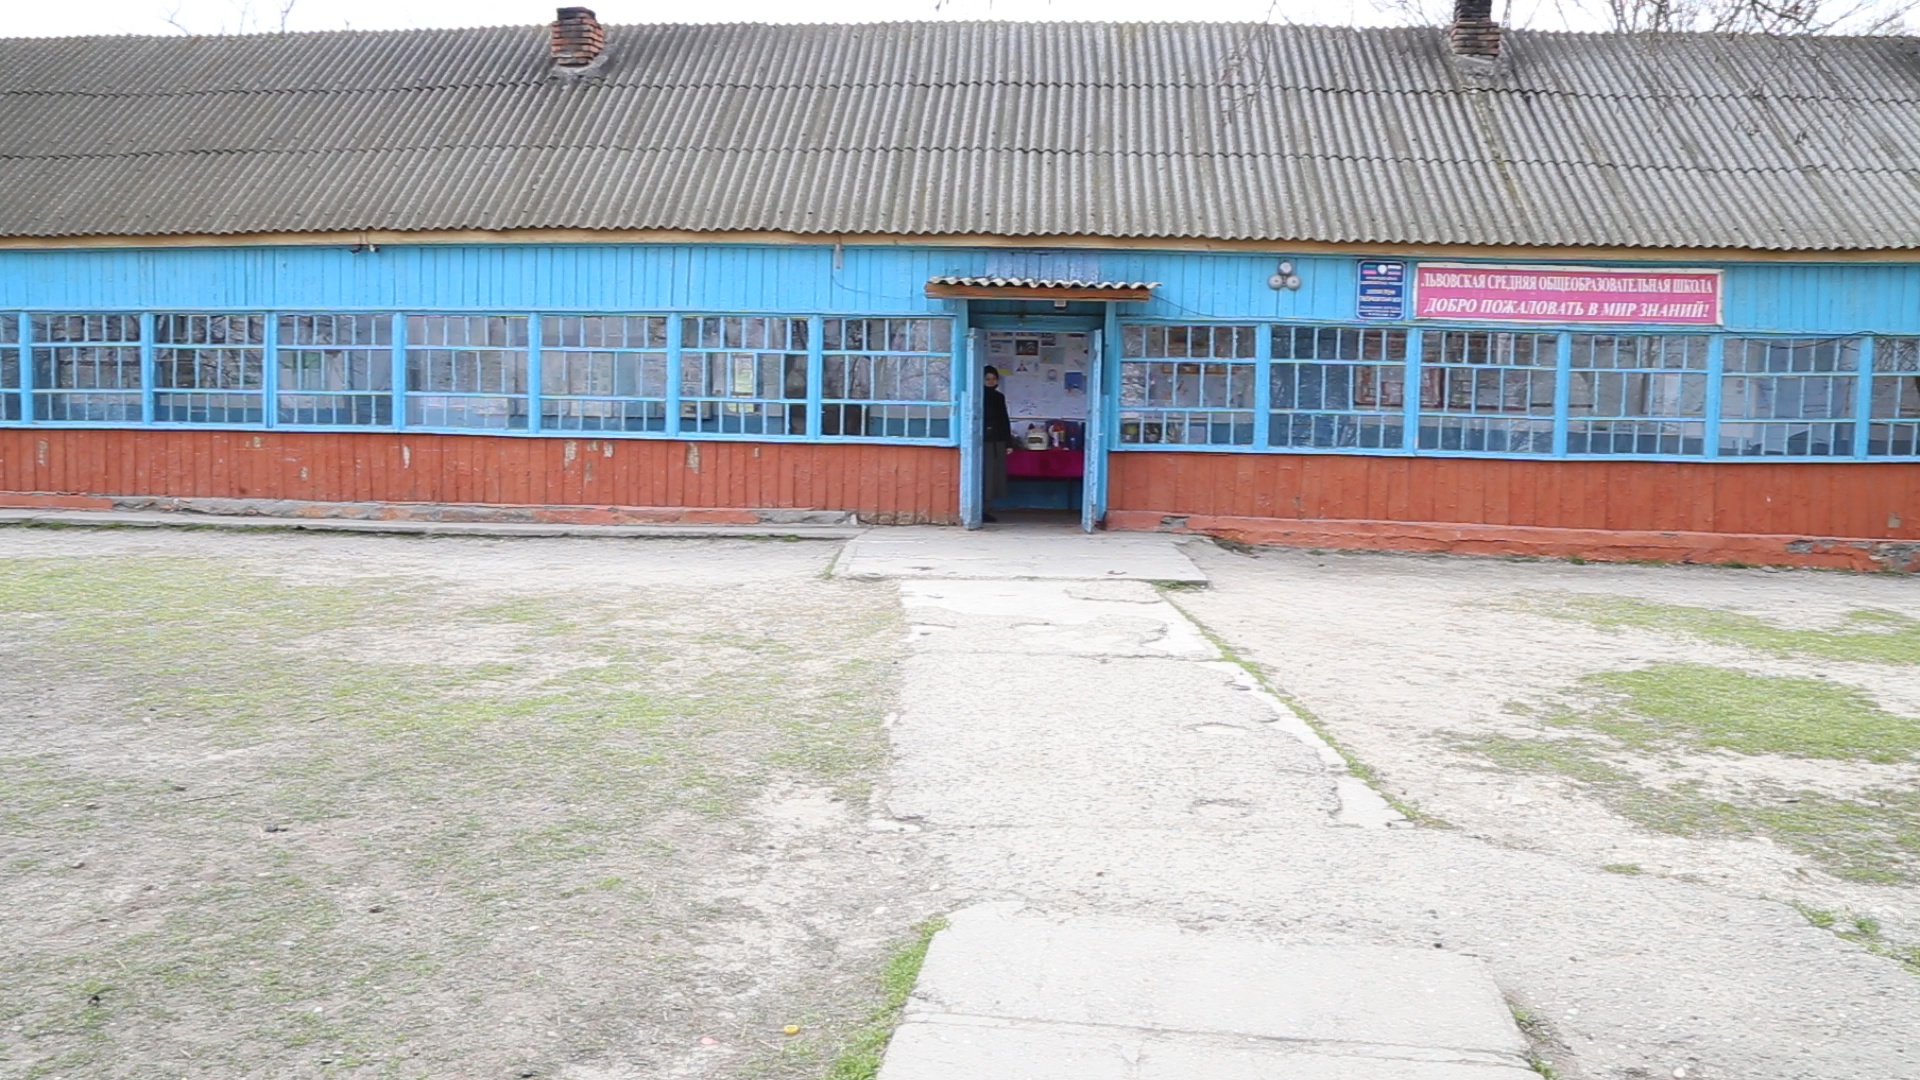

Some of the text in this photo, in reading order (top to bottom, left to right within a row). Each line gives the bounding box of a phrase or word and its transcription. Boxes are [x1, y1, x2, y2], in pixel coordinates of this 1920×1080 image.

[1421, 273, 1713, 294] ЛЬВОВСКАЯ СРЕДНЯЯ ОБЩЕОБРАЗОВАТЕЛЬНАЯ ШКОЛА
[1423, 298, 1710, 318] ДОБРО ПОЖАЛОВАТЬ В МИР ЗНАНИЙ!
